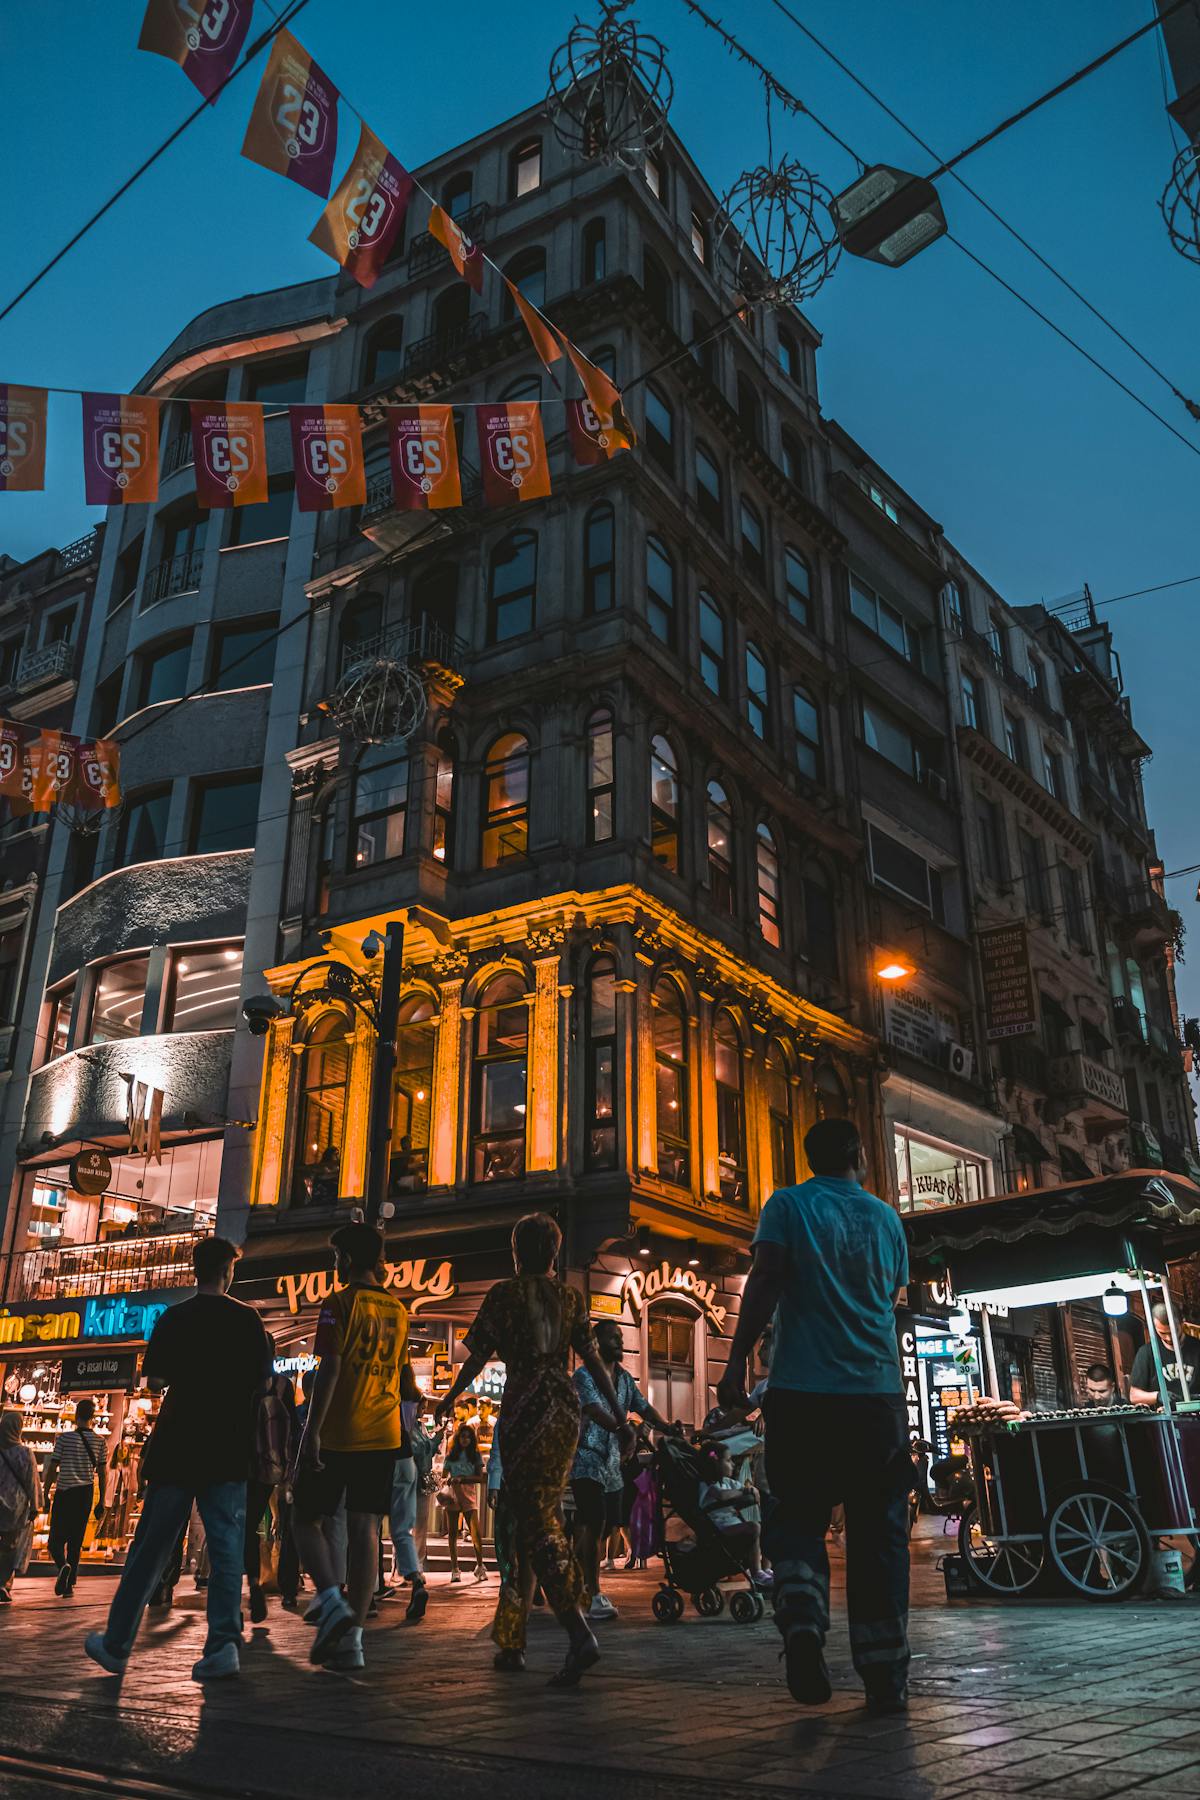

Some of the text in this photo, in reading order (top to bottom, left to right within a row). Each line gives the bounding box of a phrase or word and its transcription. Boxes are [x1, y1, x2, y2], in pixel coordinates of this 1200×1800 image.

[276, 84, 320, 147] 23
[345, 178, 387, 239] 23
[84, 1297, 169, 1342] kitap
[86, 1359, 119, 1373] insan kitap
